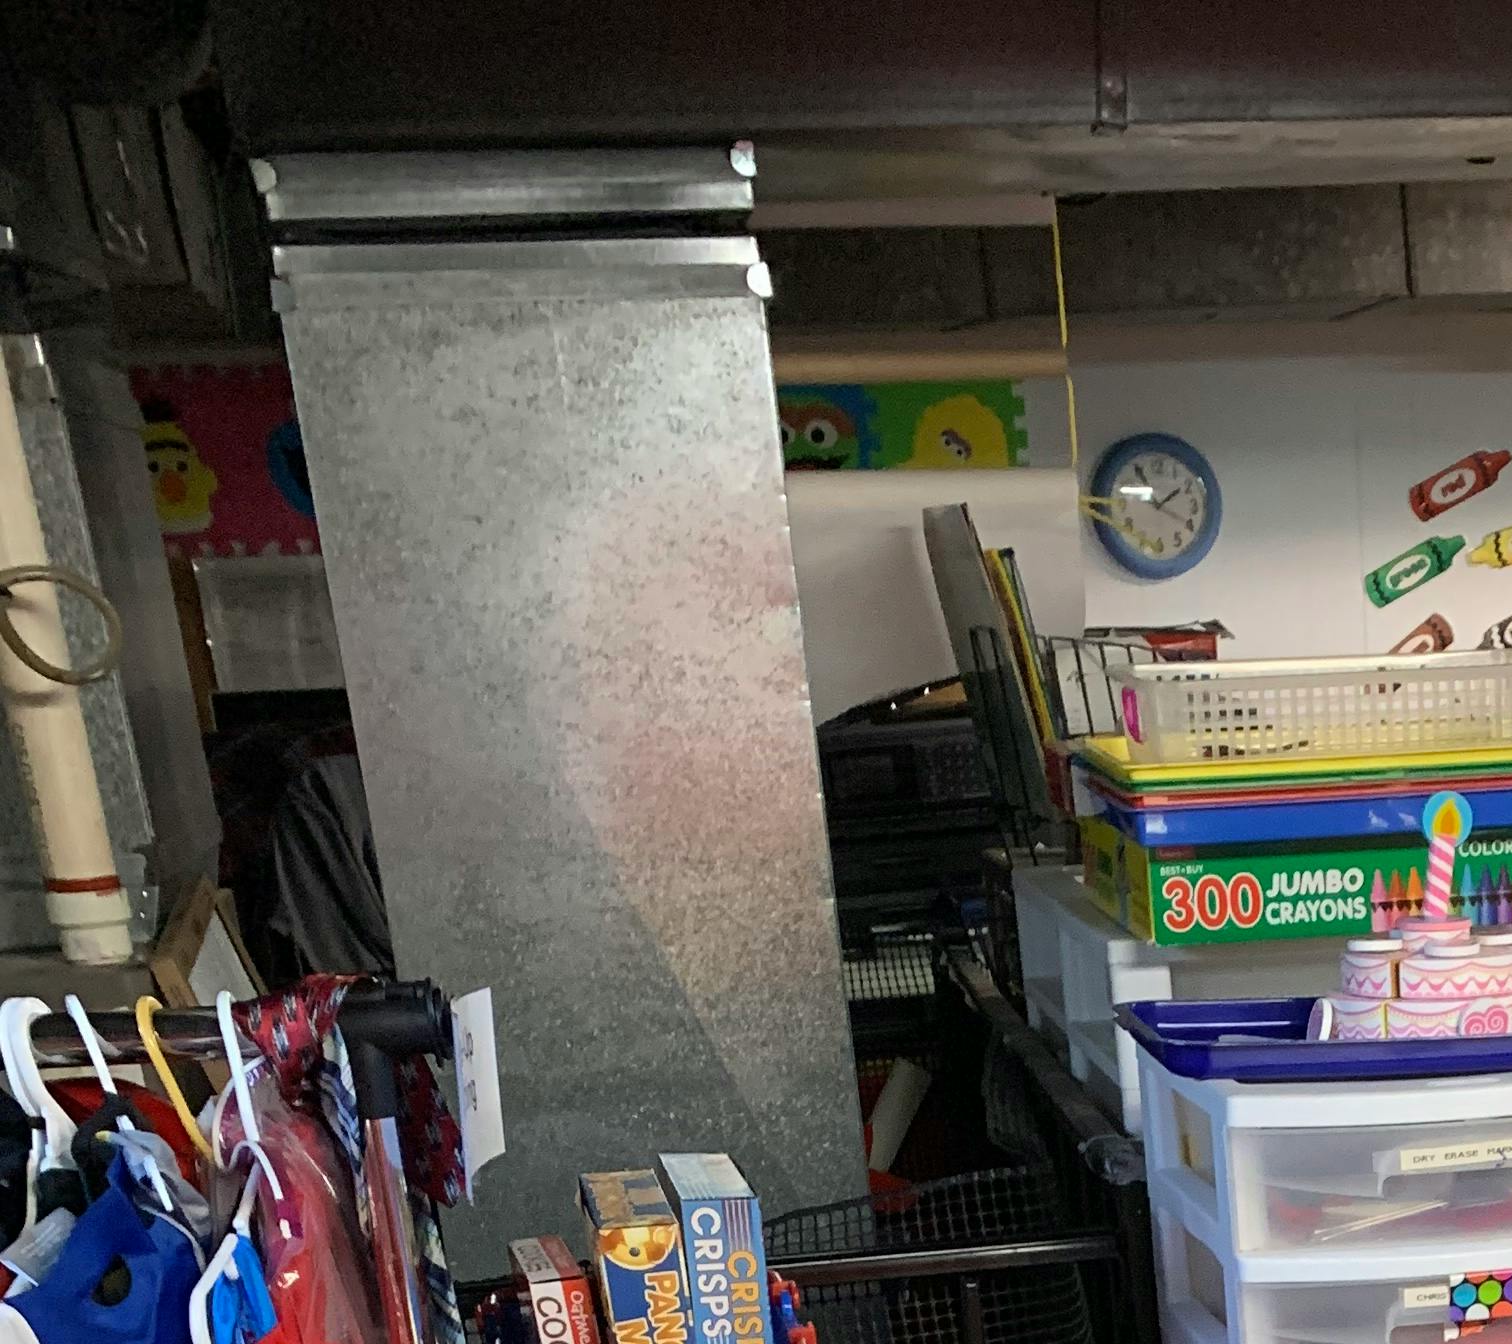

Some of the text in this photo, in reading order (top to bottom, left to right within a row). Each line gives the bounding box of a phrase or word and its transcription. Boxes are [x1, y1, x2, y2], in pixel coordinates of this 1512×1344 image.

[1440, 473, 1466, 498] red
[1265, 866, 1365, 899] JUMBO
[1163, 871, 1264, 933] 300
[1265, 896, 1368, 926] CRAYONS
[1412, 1153, 1436, 1164] DRY
[1443, 1150, 1479, 1161] ERASE
[691, 1206, 733, 1338] CRISPS
[1415, 1292, 1448, 1302] CHRIS
